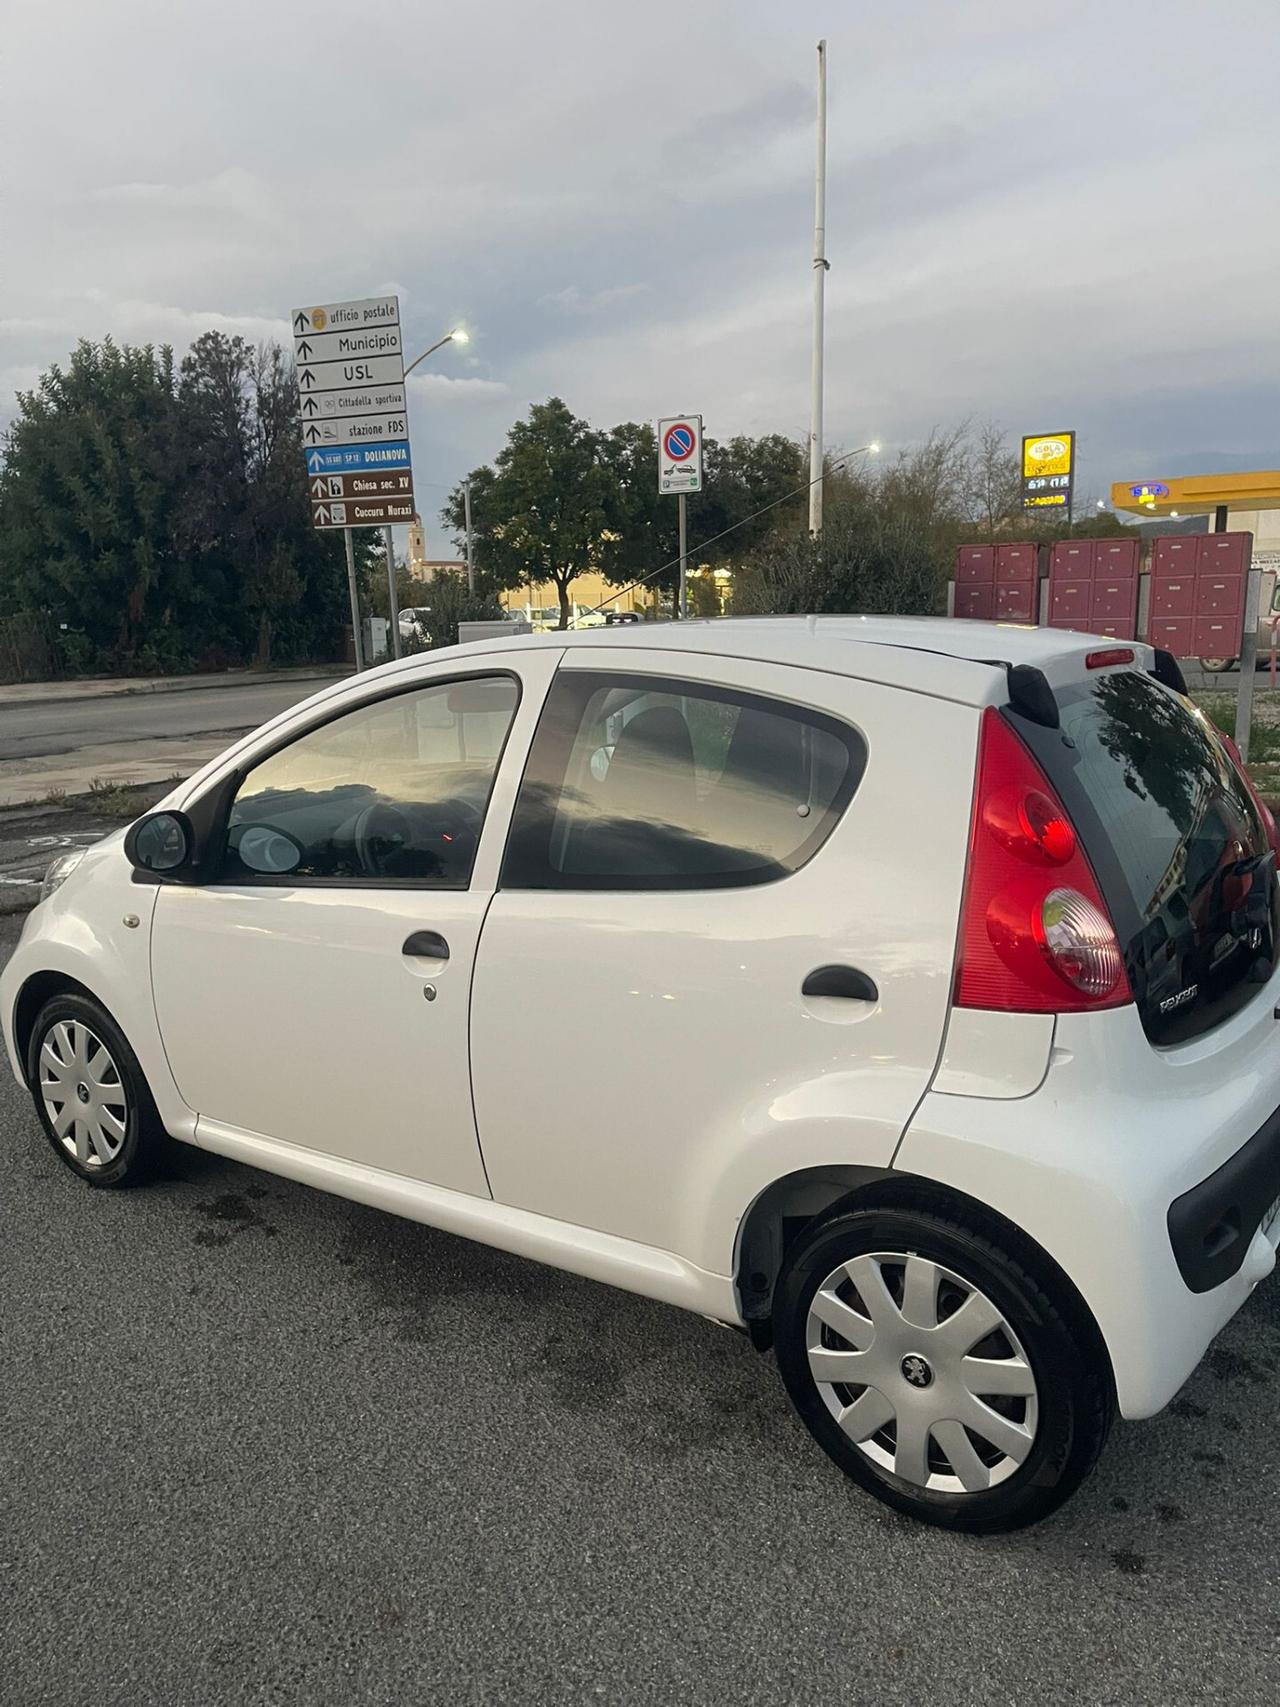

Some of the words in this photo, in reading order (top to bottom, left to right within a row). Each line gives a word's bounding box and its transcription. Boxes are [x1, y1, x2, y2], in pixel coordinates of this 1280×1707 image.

[330, 310, 359, 324] ufficio
[363, 304, 395, 321] postale
[339, 333, 397, 352] Municipio
[344, 365, 373, 381] USL
[338, 396, 372, 408] Cittadella
[375, 394, 402, 406] sportiva
[349, 423, 383, 437] stazione
[388, 420, 405, 433] FDS
[364, 448, 407, 463] DOLIANOVA
[353, 479, 377, 491] Chiesa
[380, 480, 396, 489] sec.
[398, 476, 409, 488] XV
[354, 506, 384, 518] Cuccuru
[387, 504, 412, 516] Nuraxi
